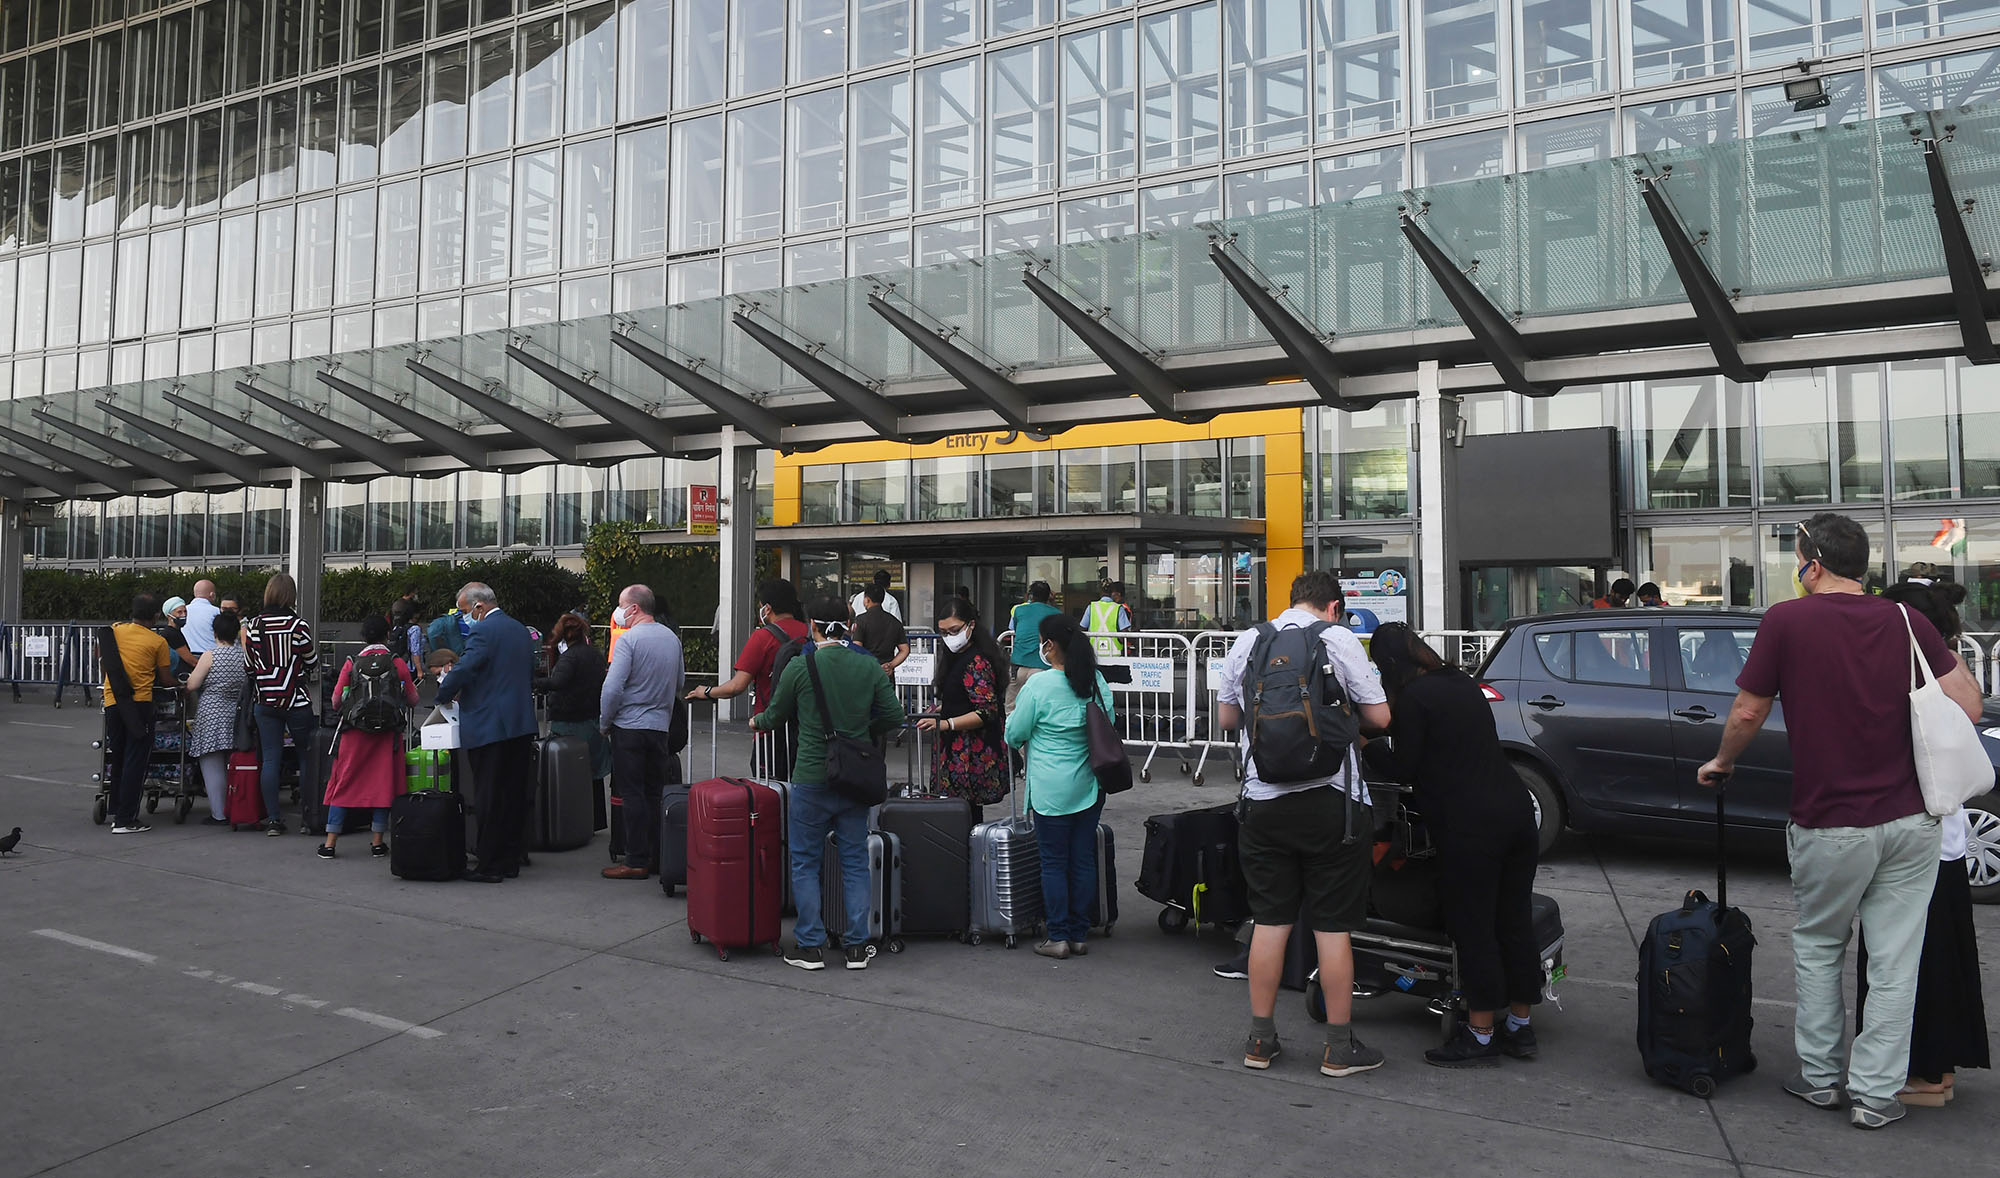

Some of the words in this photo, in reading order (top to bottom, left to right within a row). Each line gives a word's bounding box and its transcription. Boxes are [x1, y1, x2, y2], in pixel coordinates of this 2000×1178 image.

[946, 434, 989, 451] Entry
[1132, 662, 1170, 670] BIDHANNAGAR
[1140, 671, 1162, 679] TRAFFIC
[1141, 680, 1161, 688] POLICE
